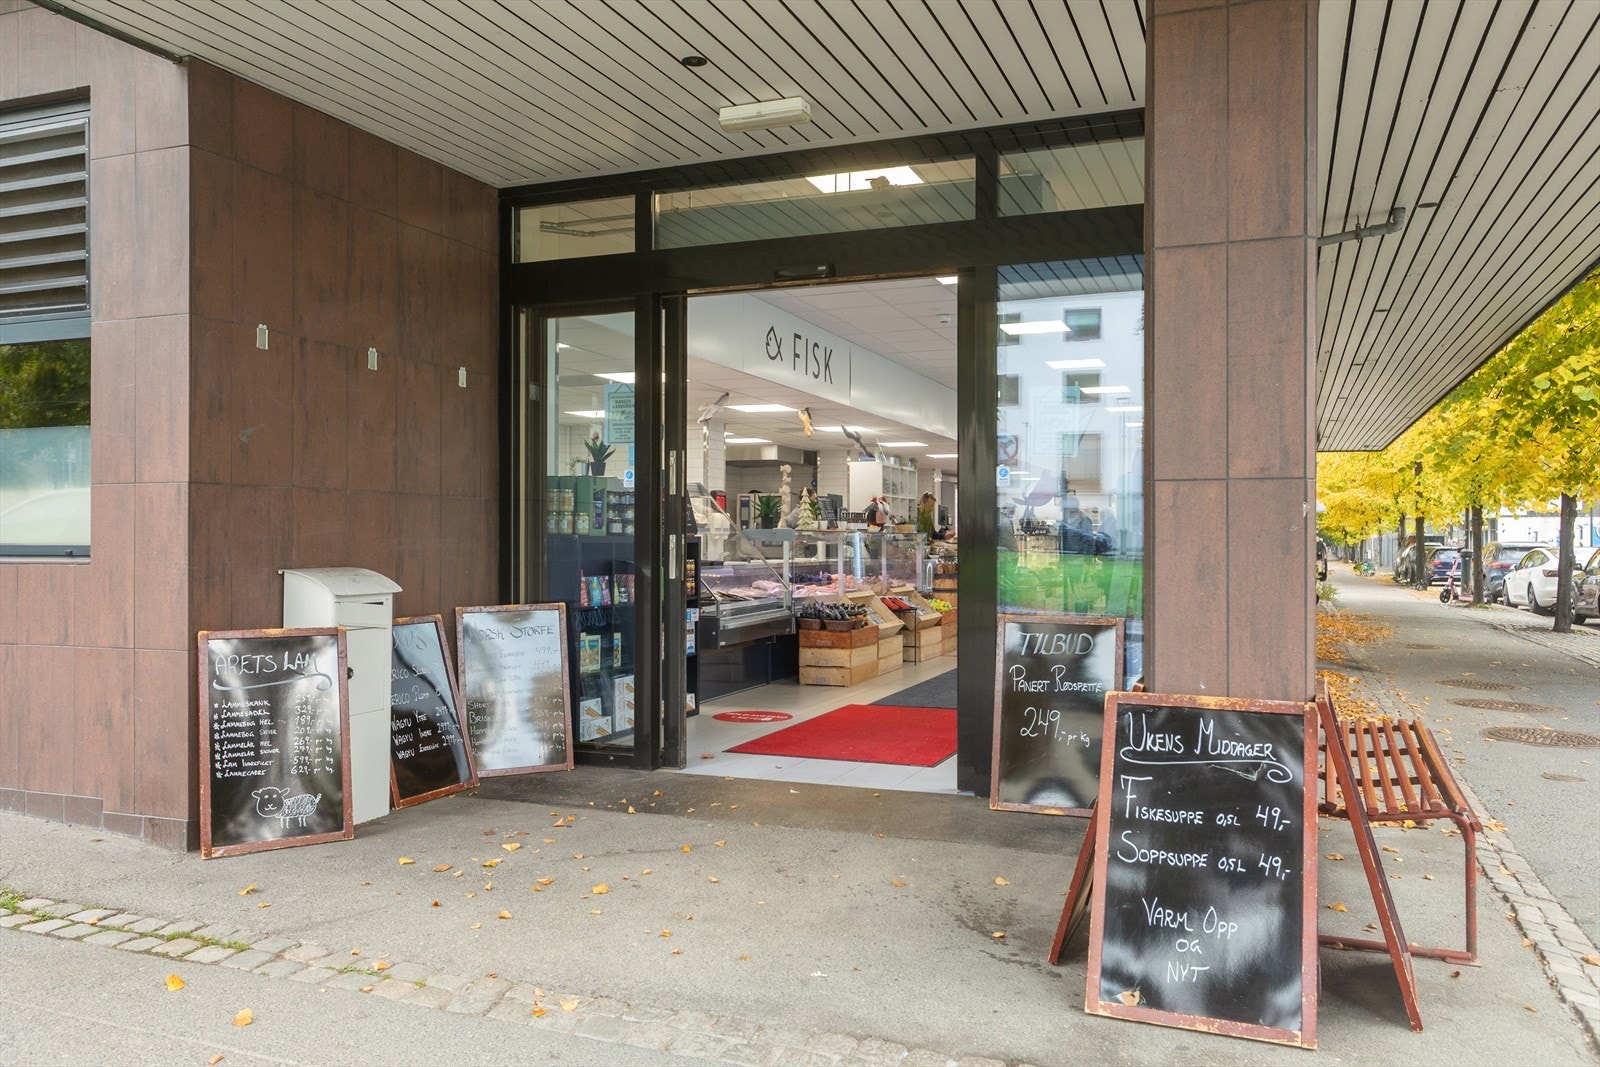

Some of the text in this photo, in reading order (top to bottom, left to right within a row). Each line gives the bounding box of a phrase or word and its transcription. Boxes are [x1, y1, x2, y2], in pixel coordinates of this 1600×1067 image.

[793, 332, 833, 384] FISK
[510, 618, 555, 639] STORFE
[1017, 631, 1094, 656] TILBUD
[283, 651, 320, 673] LAM
[1009, 664, 1102, 693] PANERT RØDSPETTE
[391, 714, 412, 731] WAGYU
[1020, 707, 1090, 748] 249,- pr kg
[392, 733, 414, 746] WAGYU
[1127, 712, 1277, 761] UKENS MIDDAGER
[396, 749, 416, 760] WAGYU
[1120, 775, 1204, 825] FISKESUPPE
[1256, 805, 1291, 832] 49,-
[1117, 830, 1209, 868] SOPPSUPPE
[1259, 853, 1291, 880] 49,-
[1142, 897, 1238, 939] VARM OPP
[1176, 939, 1203, 954] OG
[1167, 961, 1210, 984] NYT
